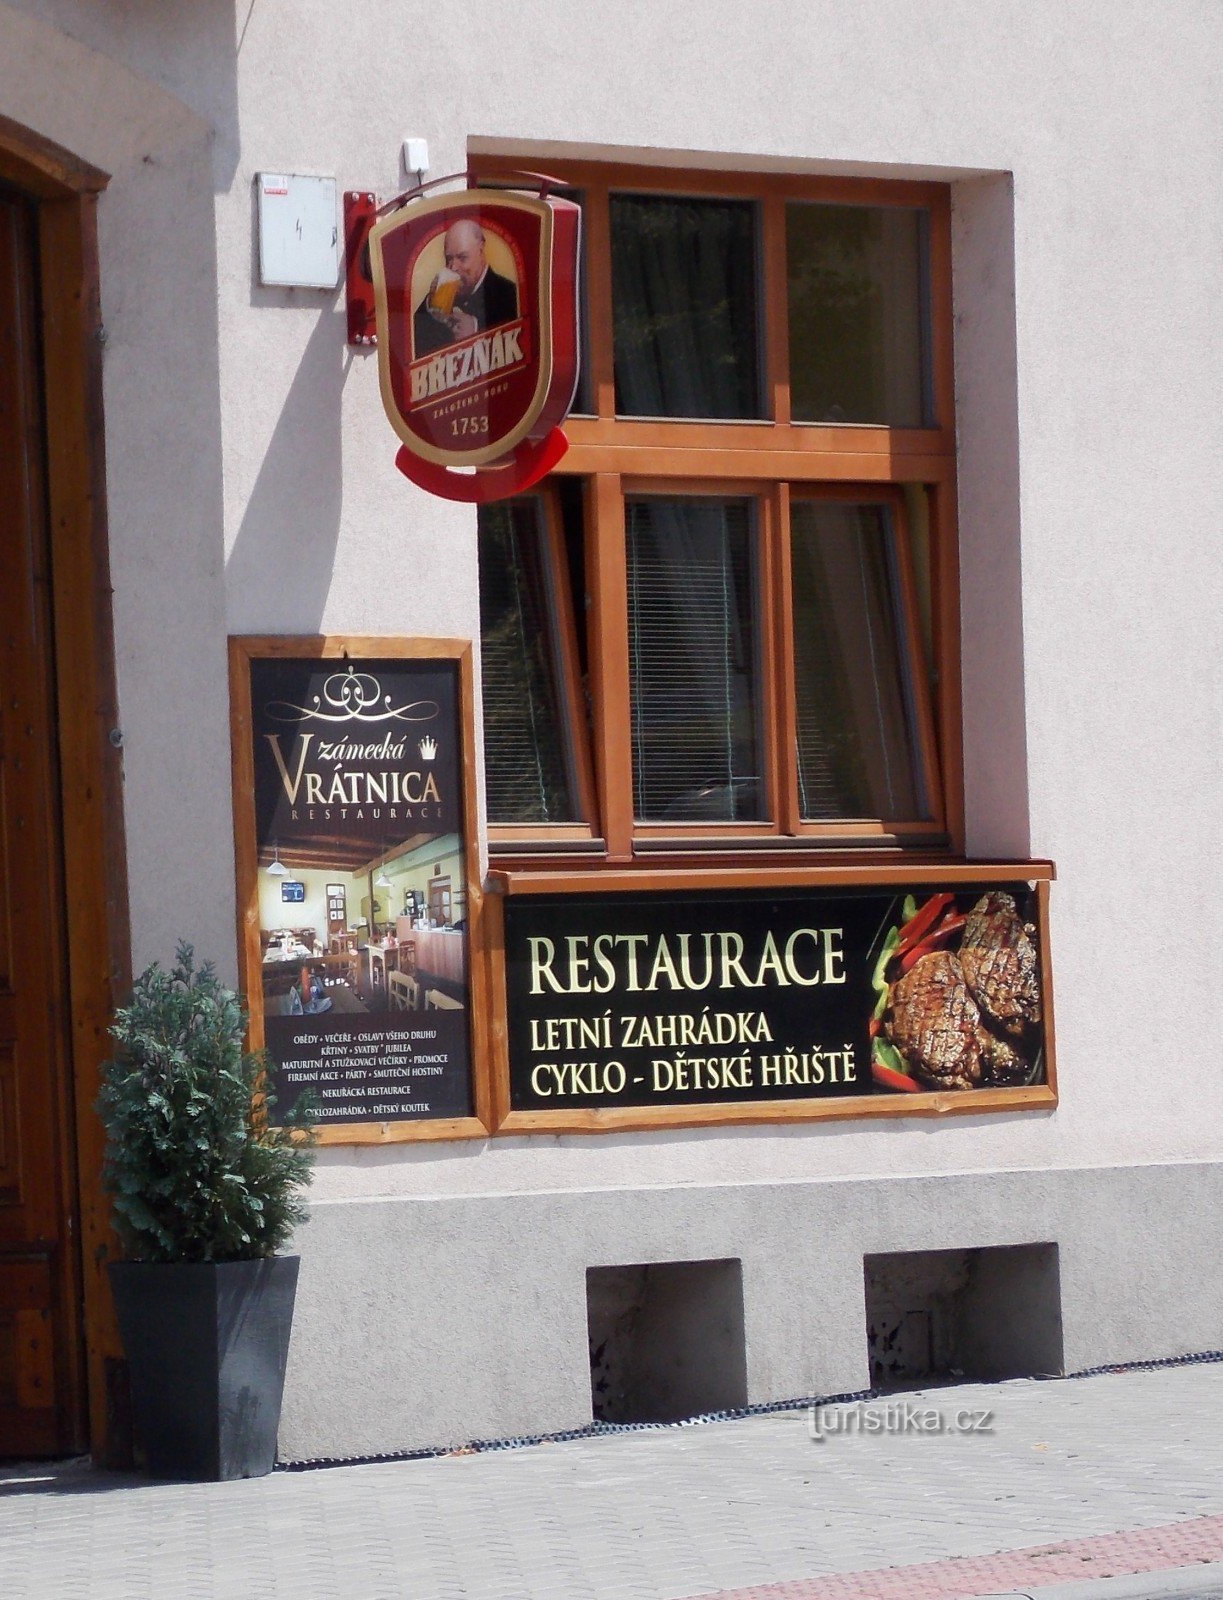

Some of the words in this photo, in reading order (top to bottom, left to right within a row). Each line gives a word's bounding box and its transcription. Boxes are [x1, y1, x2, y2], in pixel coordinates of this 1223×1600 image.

[451, 415, 489, 436] 1753
[317, 731, 407, 760] zámecká
[263, 733, 442, 806] VRÁTNICA
[291, 808, 443, 820] RESTAURACE
[526, 928, 847, 995] RESTAURACE
[530, 1010, 612, 1051] LETNÍ
[620, 1006, 774, 1047] ZAHRÁDKA
[293, 1034, 319, 1045] OBĚDY
[325, 1033, 352, 1043] VEČEŘE
[358, 1032, 385, 1042] OSLAVY
[385, 1031, 409, 1041] VŠEHO
[411, 1030, 437, 1040] DRUHU
[321, 1046, 349, 1056] KŘTINY
[354, 1045, 379, 1054] SVATBY
[385, 1043, 412, 1054] JUBILEA
[282, 1058, 324, 1070] MATURITNÍ
[325, 1059, 330, 1068] A
[331, 1056, 377, 1068] STUŽKOVACÍ
[378, 1055, 408, 1066] VEČÍRKY
[413, 1054, 449, 1064] PROMOCE
[531, 1060, 626, 1096] CYKLO
[652, 1051, 753, 1092] DĚTSKÉ
[760, 1044, 857, 1086] HŘIŠTĚ
[287, 1071, 319, 1081] FIREMNÍ
[320, 1071, 339, 1080] AKCE
[345, 1069, 368, 1079] PÁRTY
[373, 1067, 410, 1079] SMUTEČNÍ
[412, 1067, 444, 1076] HOSTINY
[322, 1087, 366, 1098] NEKUŘÁCKÁ
[367, 1086, 411, 1096] RESTAURACE
[373, 1103, 400, 1114] DĚTSKÝ
[401, 1103, 430, 1113] KOUTEK
